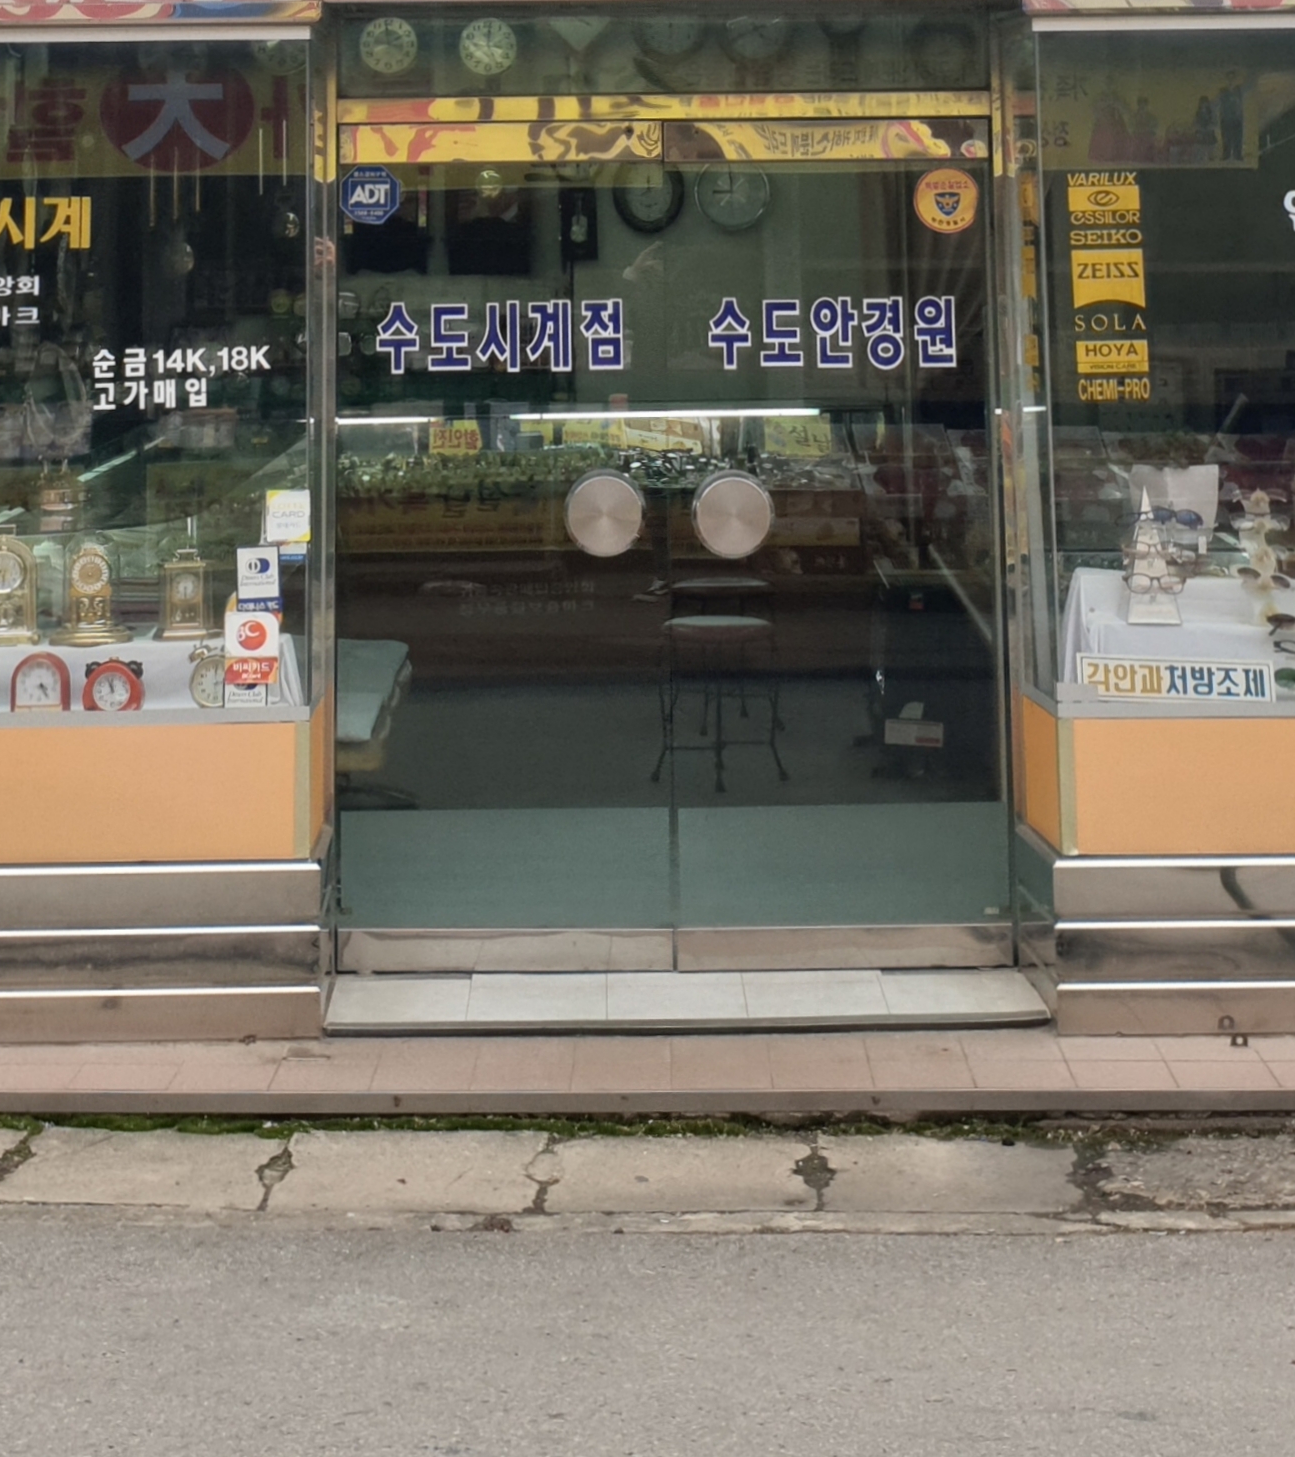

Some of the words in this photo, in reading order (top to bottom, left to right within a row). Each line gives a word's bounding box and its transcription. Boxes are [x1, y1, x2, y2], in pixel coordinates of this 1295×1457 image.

[1067, 172, 1137, 186] VARILUX
[348, 183, 391, 205] ADT
[1069, 229, 1142, 245] SEIKO
[1076, 261, 1140, 280] ZEISS
[1074, 313, 1147, 332] SOLA
[374, 297, 625, 375] 수도시계점
[707, 295, 957, 370] 수도안경원
[1084, 342, 1139, 358] HOYA
[92, 347, 147, 379] 순금
[1078, 378, 1151, 401] CHEMI-PRO
[272, 510, 305, 519] CARD
